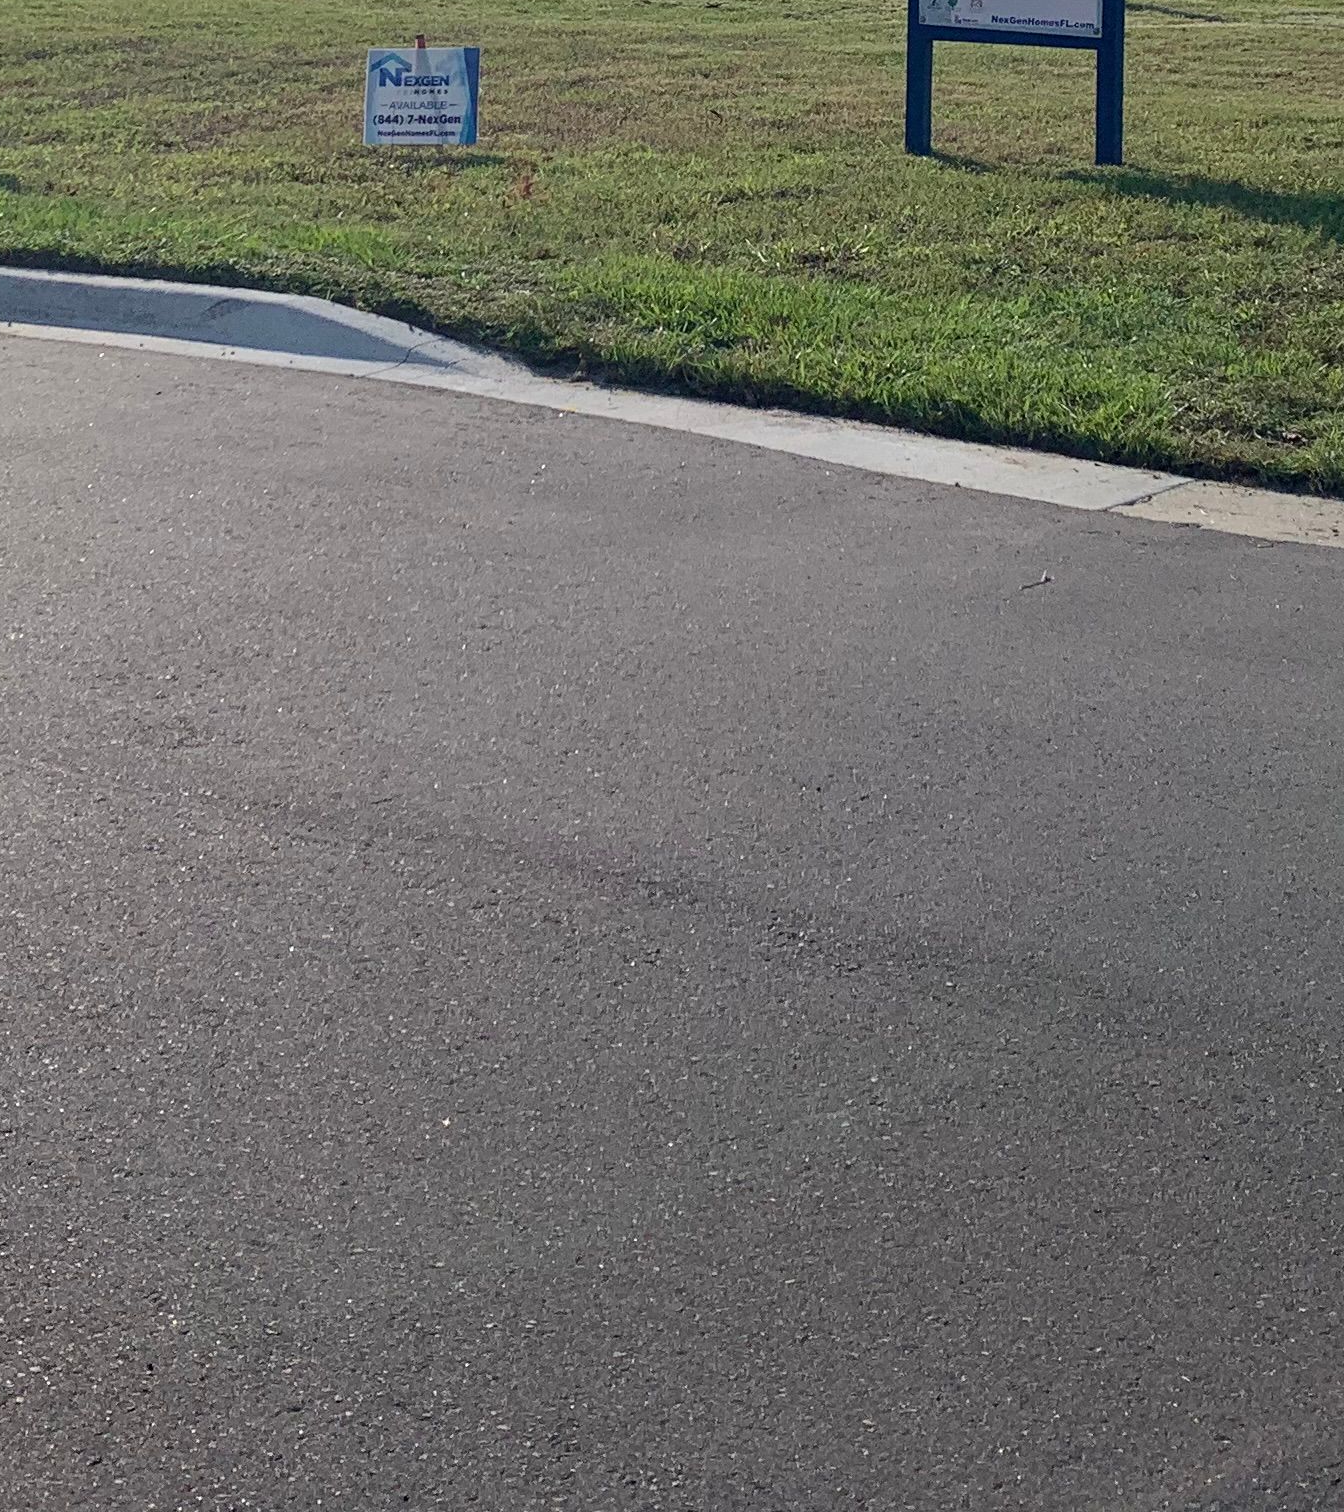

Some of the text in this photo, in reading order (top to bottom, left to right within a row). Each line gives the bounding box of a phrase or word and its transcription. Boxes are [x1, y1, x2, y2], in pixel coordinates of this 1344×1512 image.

[991, 16, 1095, 29] NexGenHomesFL.com
[379, 68, 449, 87] NEXGEN
[389, 101, 448, 110] AVAILABLE
[373, 114, 461, 126] (844) 7-NexGen
